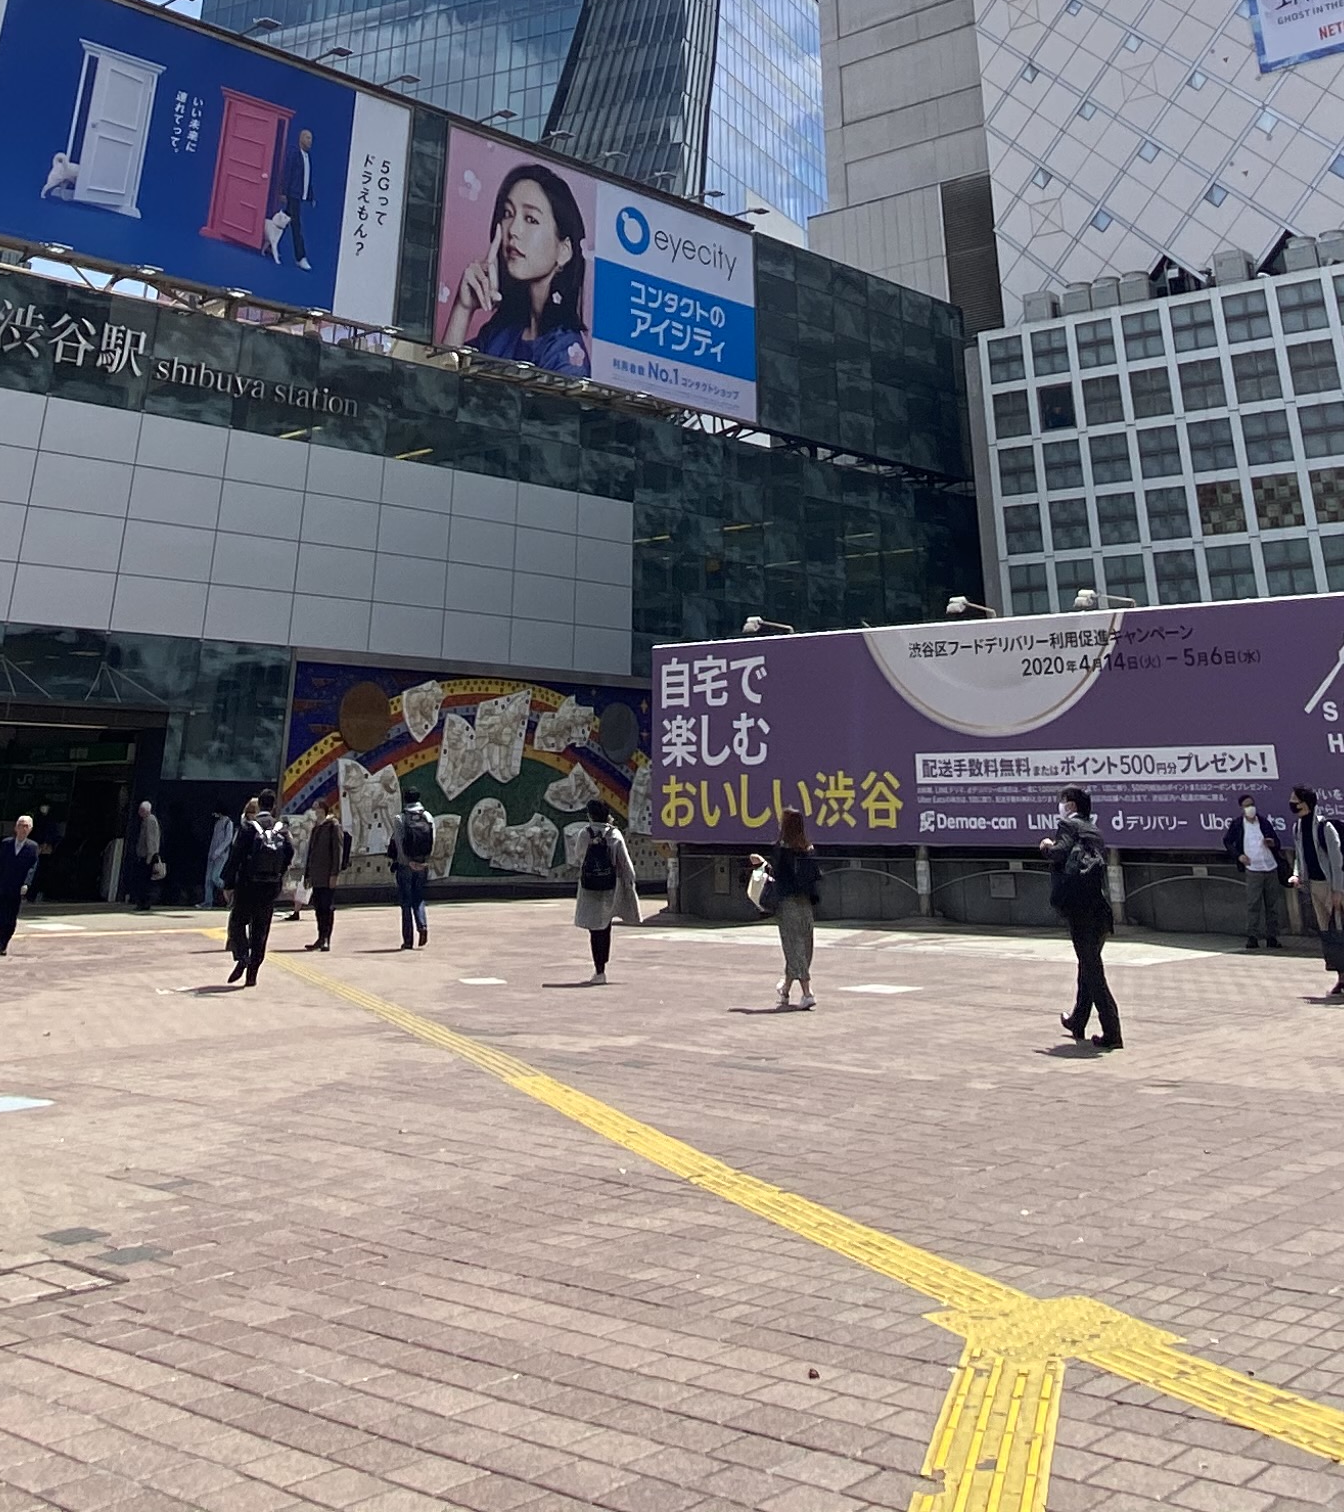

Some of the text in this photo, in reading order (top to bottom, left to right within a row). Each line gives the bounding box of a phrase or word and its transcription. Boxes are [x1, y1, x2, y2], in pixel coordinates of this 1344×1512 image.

[1277, 9, 1311, 25] GHOST
[1312, 4, 1324, 15] IN
[1325, 0, 1344, 13] THE
[374, 159, 393, 227] 5Gって
[653, 229, 737, 281] eyecity
[630, 280, 726, 329] コンタクトの
[629, 308, 725, 363] アイシティ
[156, 356, 266, 402] shibuya
[273, 379, 361, 419] station
[908, 625, 1194, 659] 渋谷区フードデリバリー利用促進キャンペーン
[660, 654, 768, 710] 自宅で
[661, 712, 771, 769] 楽しむ
[660, 770, 904, 830] おいしい渋谷
[937, 813, 1017, 830] Demae-can
